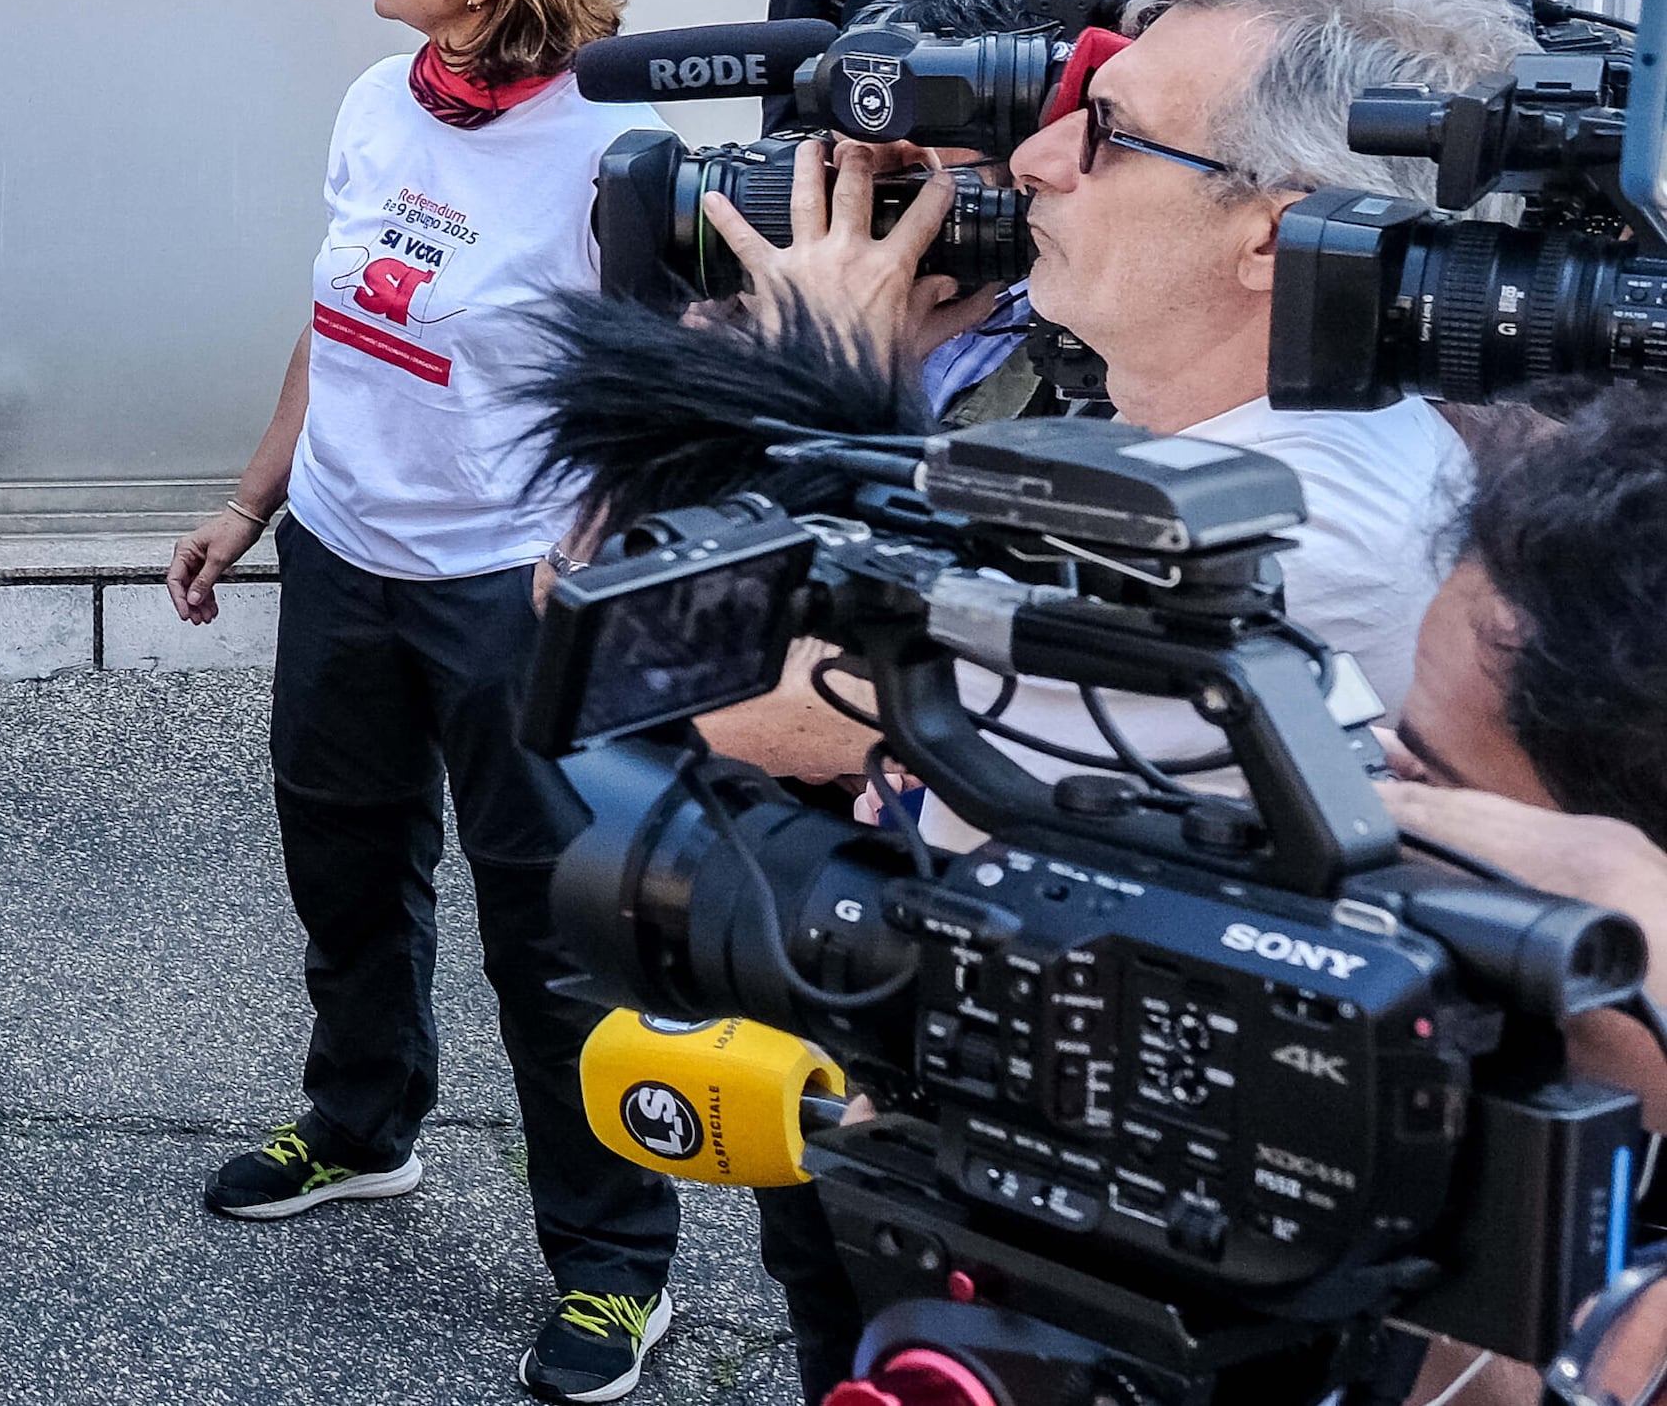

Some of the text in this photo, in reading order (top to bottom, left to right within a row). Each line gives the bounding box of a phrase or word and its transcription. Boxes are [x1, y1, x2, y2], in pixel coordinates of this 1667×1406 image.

[649, 53, 769, 91] RØDE
[398, 188, 467, 225] Referendum
[379, 229, 444, 267] SI VOTA
[441, 220, 480, 245] 2025
[1497, 322, 1517, 336] G
[835, 898, 864, 924] G
[1221, 923, 1367, 979] SONY
[1270, 1044, 1350, 1086] 4K
